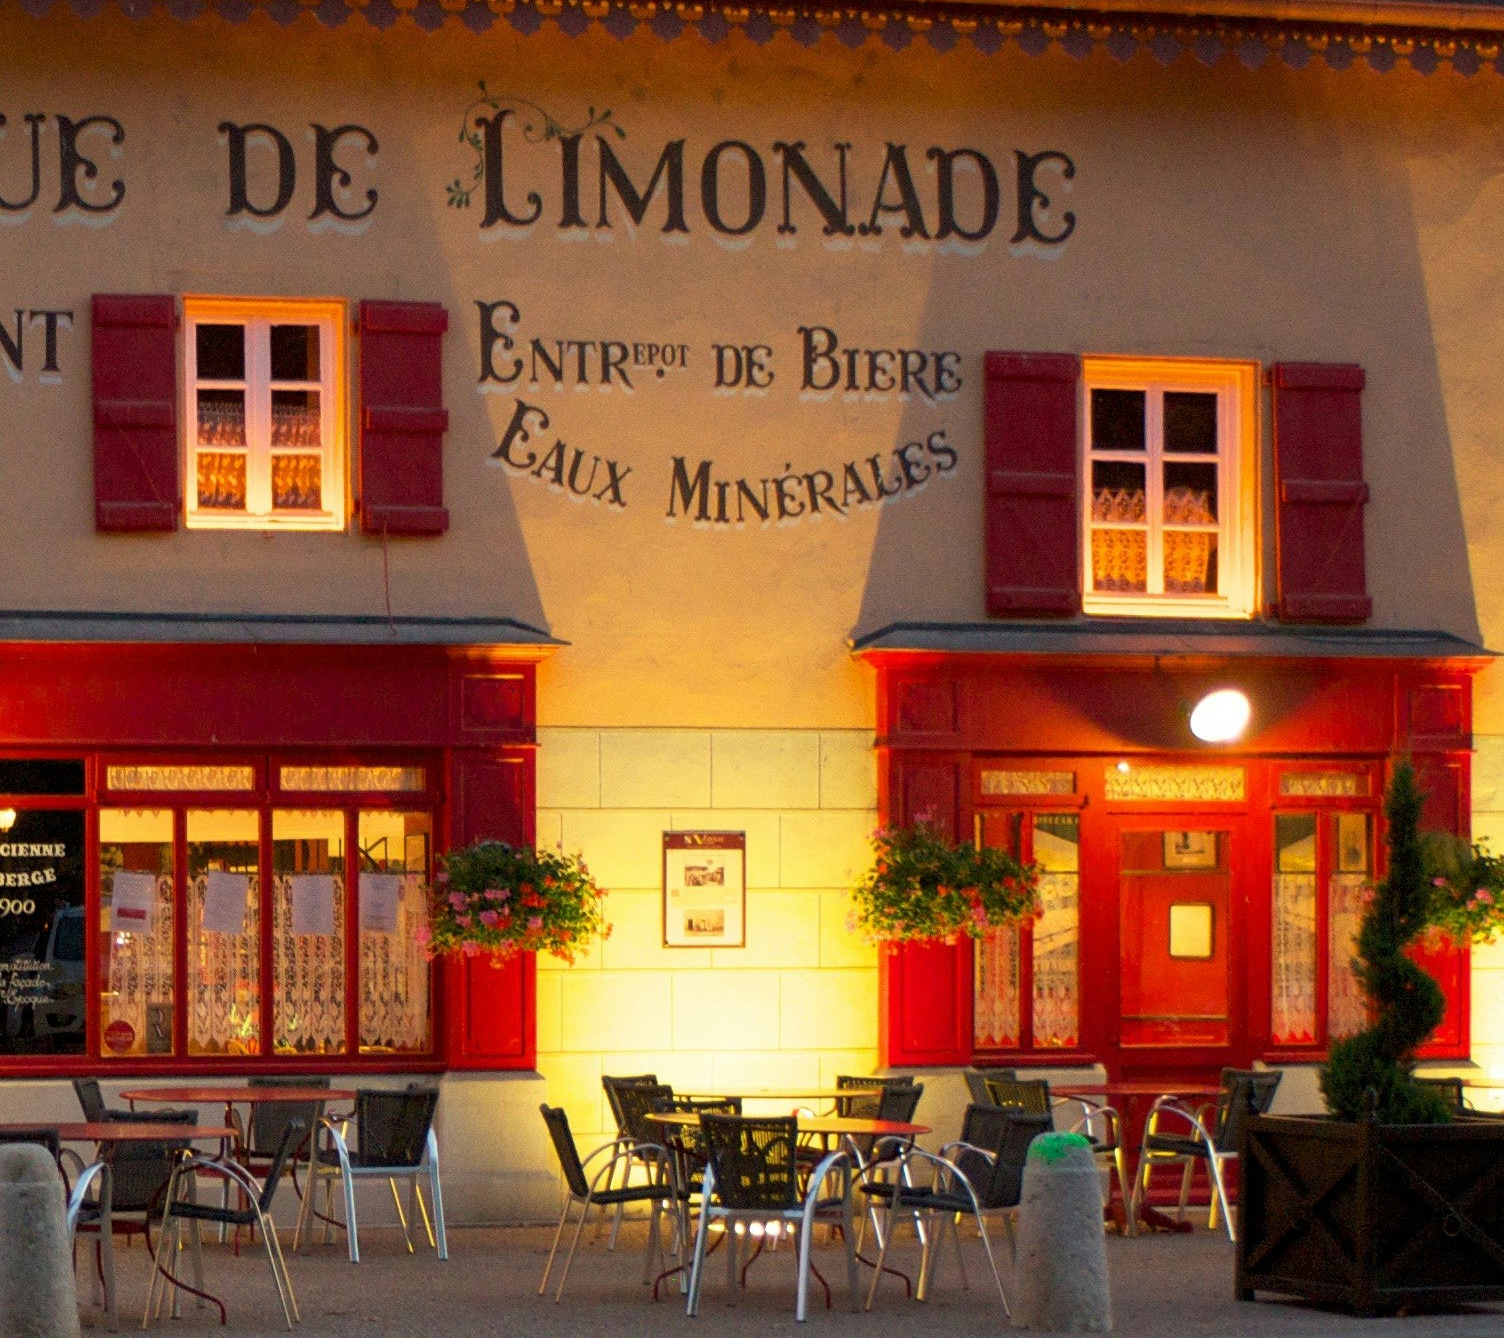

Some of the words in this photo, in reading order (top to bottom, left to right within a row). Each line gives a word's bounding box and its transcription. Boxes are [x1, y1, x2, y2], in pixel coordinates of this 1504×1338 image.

[217, 120, 379, 222] DE
[474, 108, 1078, 245] LIMONADE
[712, 343, 775, 389] DE
[796, 325, 963, 399] BIERE
[492, 398, 632, 508] EAUX
[665, 429, 959, 524] MINÉRALES
